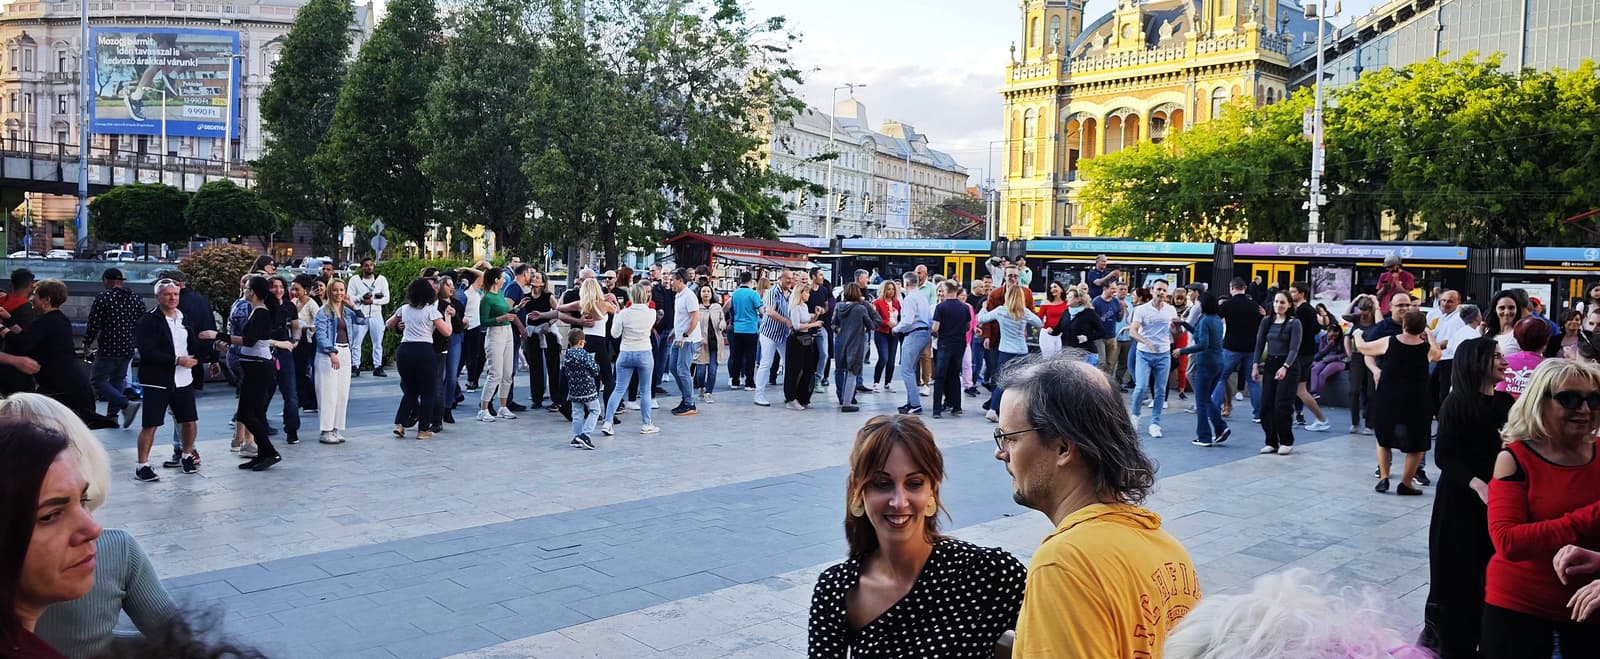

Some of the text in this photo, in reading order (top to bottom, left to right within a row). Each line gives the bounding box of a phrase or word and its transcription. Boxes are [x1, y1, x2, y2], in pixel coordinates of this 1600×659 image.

[173, 47, 180, 56] is
[136, 56, 166, 66] árakkal
[166, 57, 198, 67] várunk!
